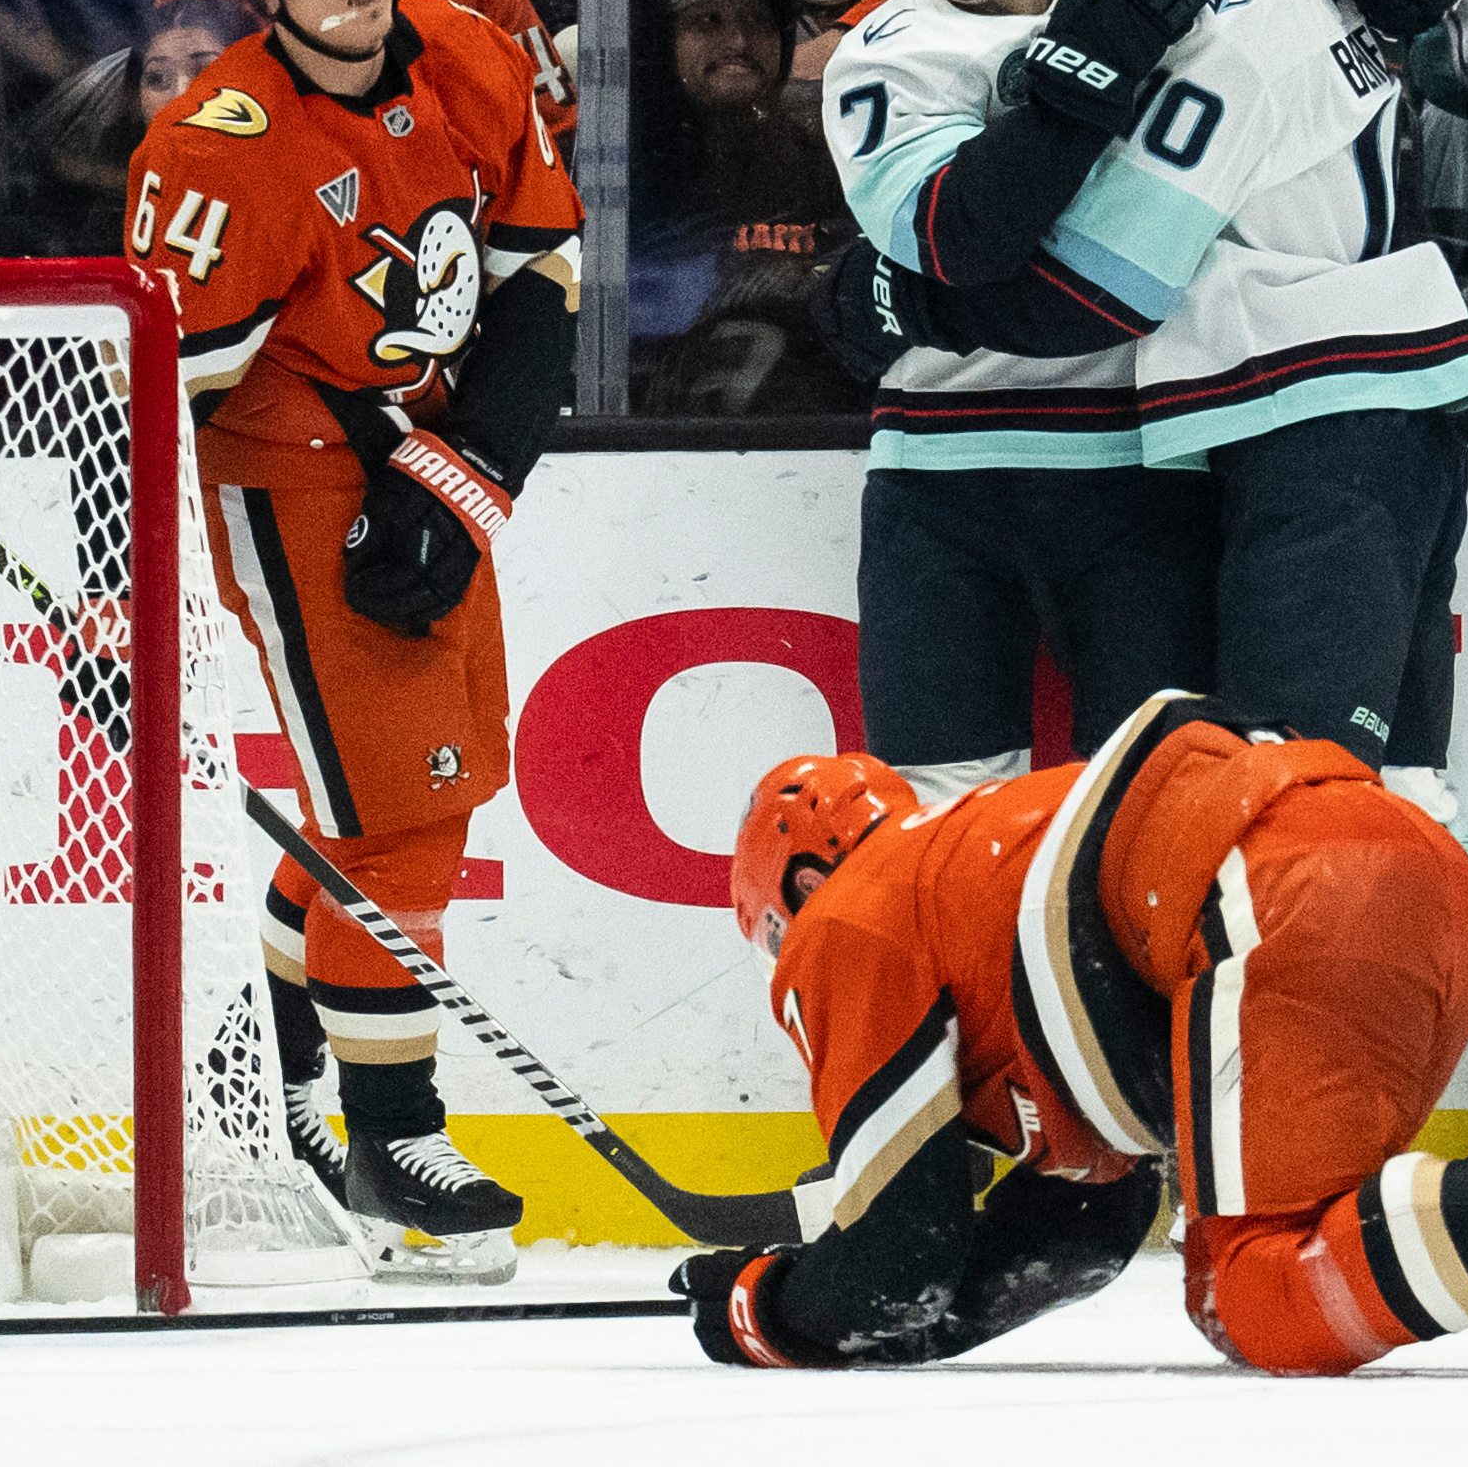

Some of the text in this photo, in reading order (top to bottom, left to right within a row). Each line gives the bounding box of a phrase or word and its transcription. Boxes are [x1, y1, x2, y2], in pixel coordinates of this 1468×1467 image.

[839, 79, 890, 159] 7
[1141, 78, 1225, 172] 0
[131, 169, 230, 283] 64
[342, 897, 609, 1138] WARRIOR
